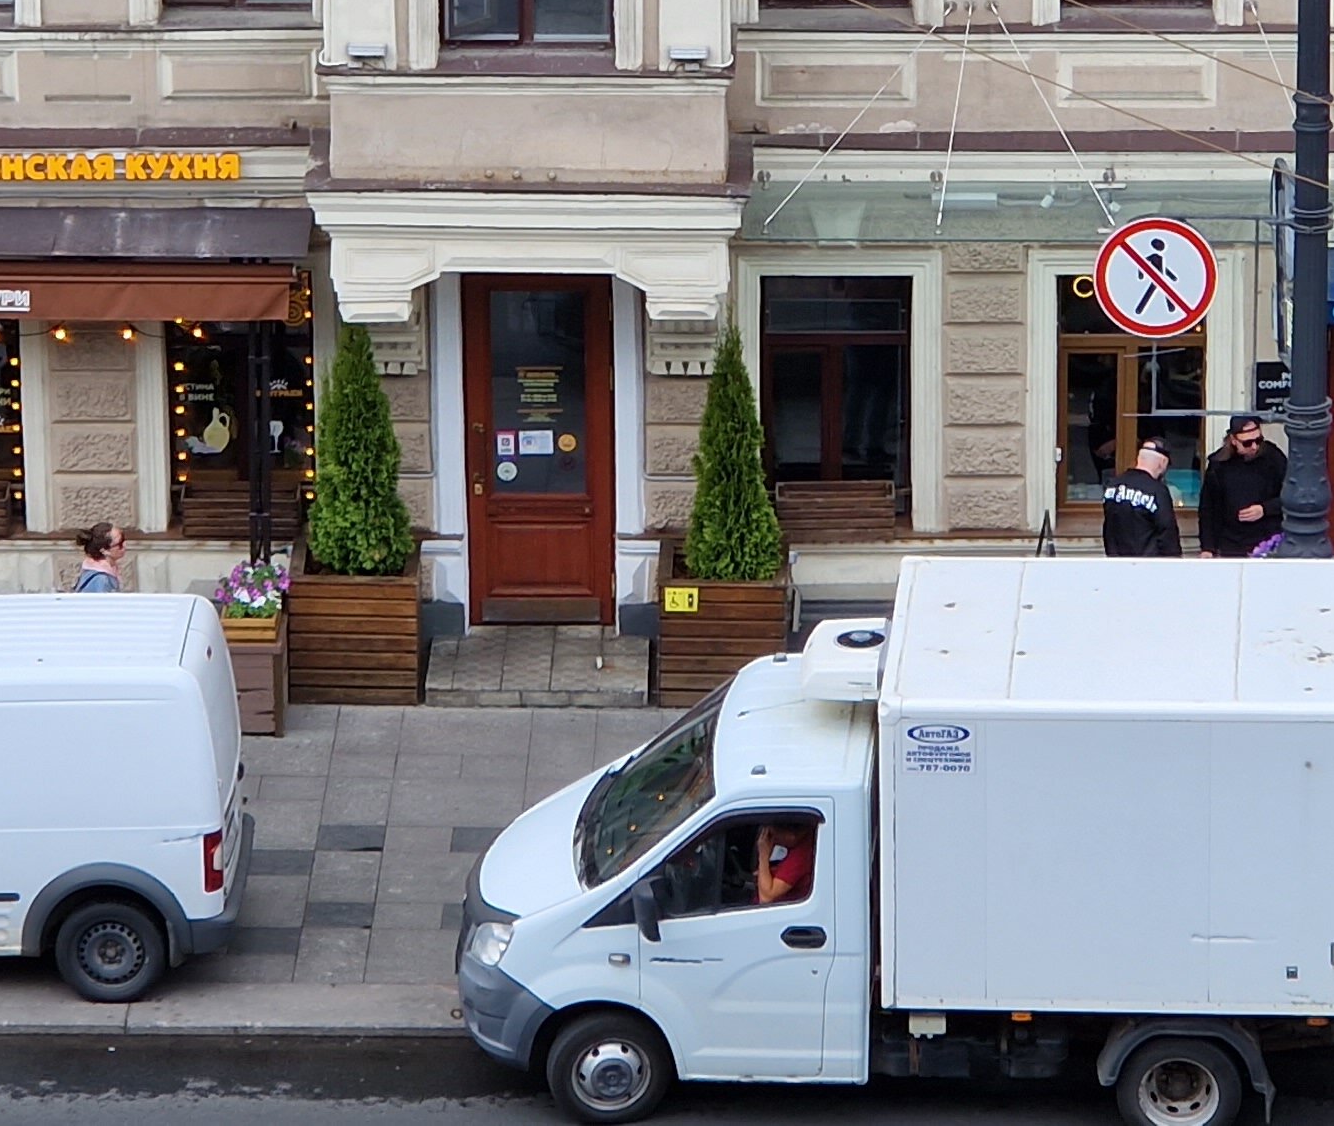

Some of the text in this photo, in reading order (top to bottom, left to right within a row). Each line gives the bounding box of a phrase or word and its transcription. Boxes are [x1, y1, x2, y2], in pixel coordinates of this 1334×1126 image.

[124, 152, 242, 181] КУХНЯ
[1258, 380, 1292, 389] COMF
[918, 729, 959, 739] АвтоГАЗ
